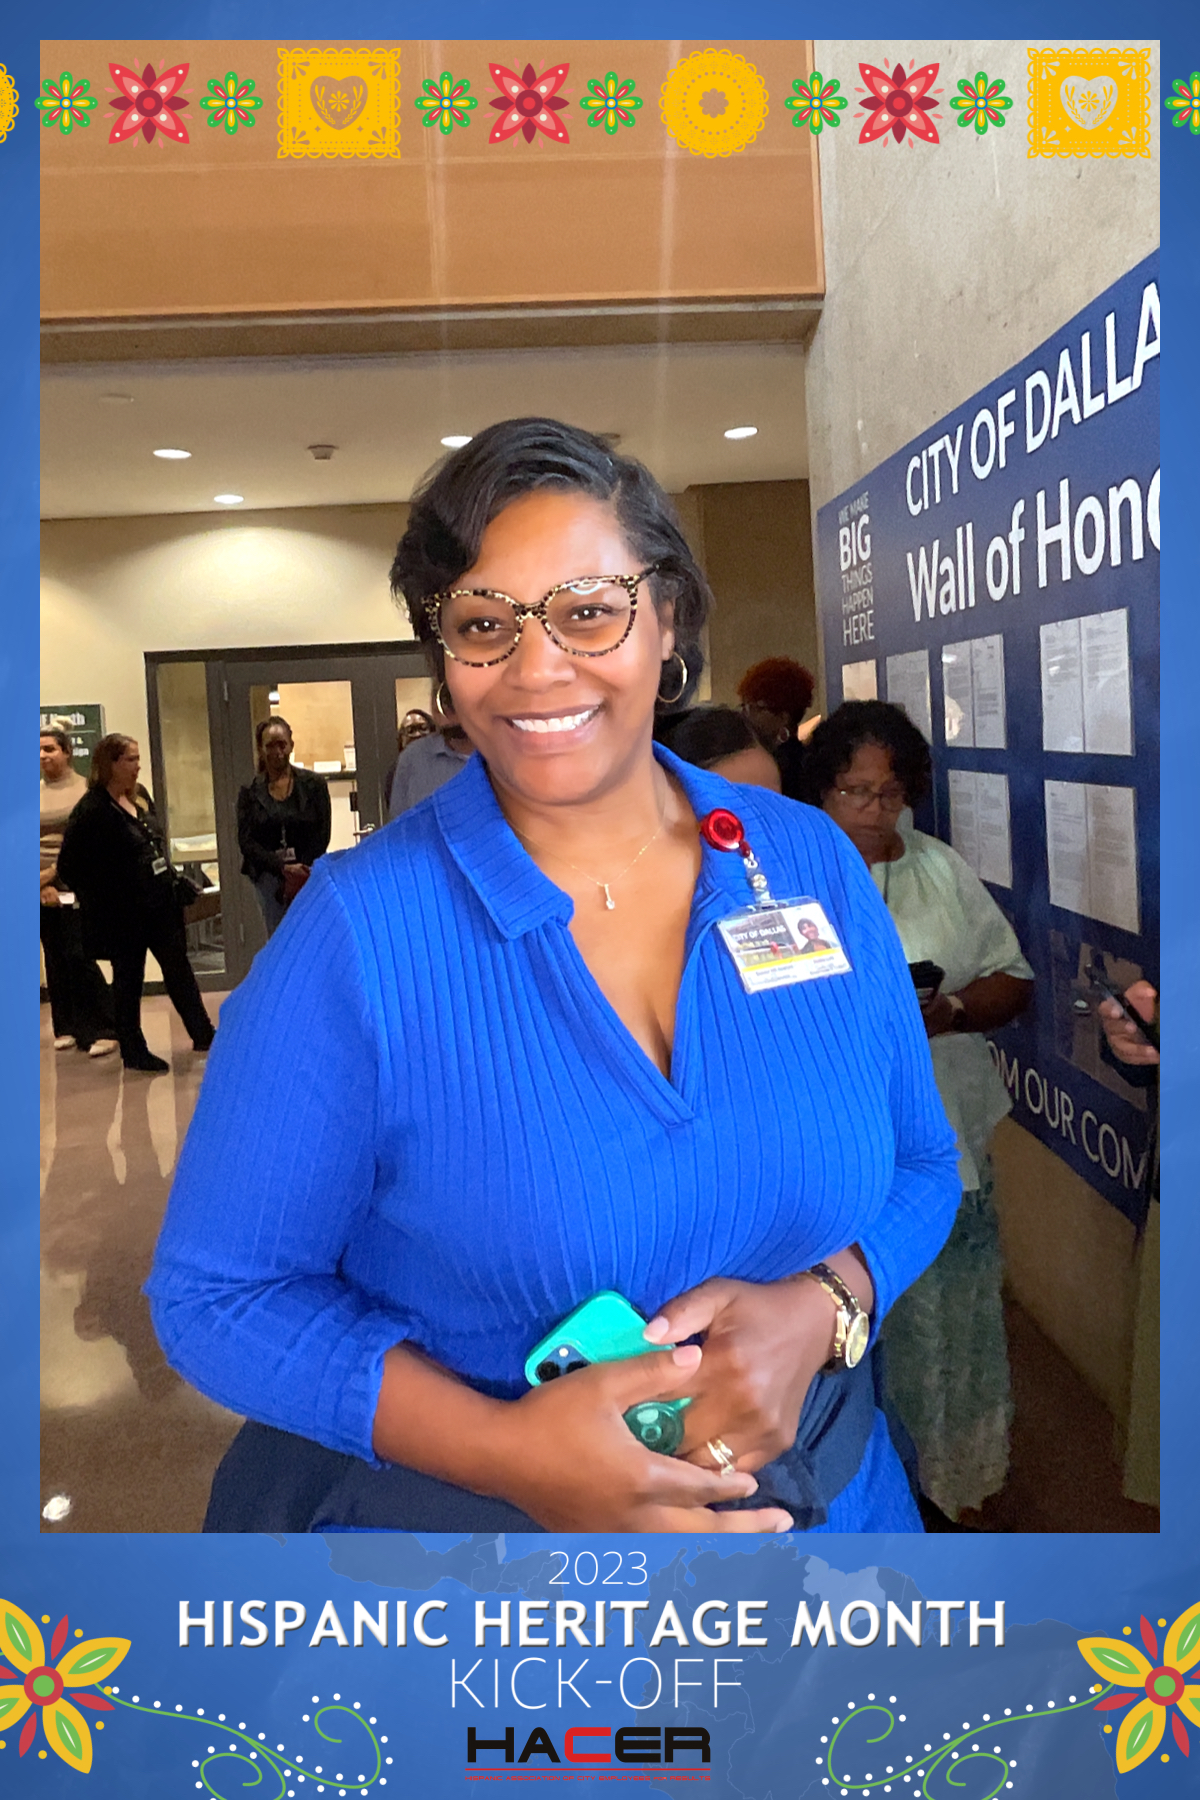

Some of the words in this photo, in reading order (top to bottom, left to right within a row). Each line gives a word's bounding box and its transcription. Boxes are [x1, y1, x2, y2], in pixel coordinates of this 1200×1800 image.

[905, 424, 963, 516] CITY
[970, 388, 1016, 480] OF
[1024, 281, 1160, 454] DALLA
[839, 514, 871, 572] BIG
[906, 521, 976, 622] Wall
[985, 499, 1026, 601] of
[841, 562, 873, 594] THINGS
[842, 586, 874, 615] HAPPEN
[843, 610, 875, 647] HERE
[1025, 1068, 1077, 1146] OUR
